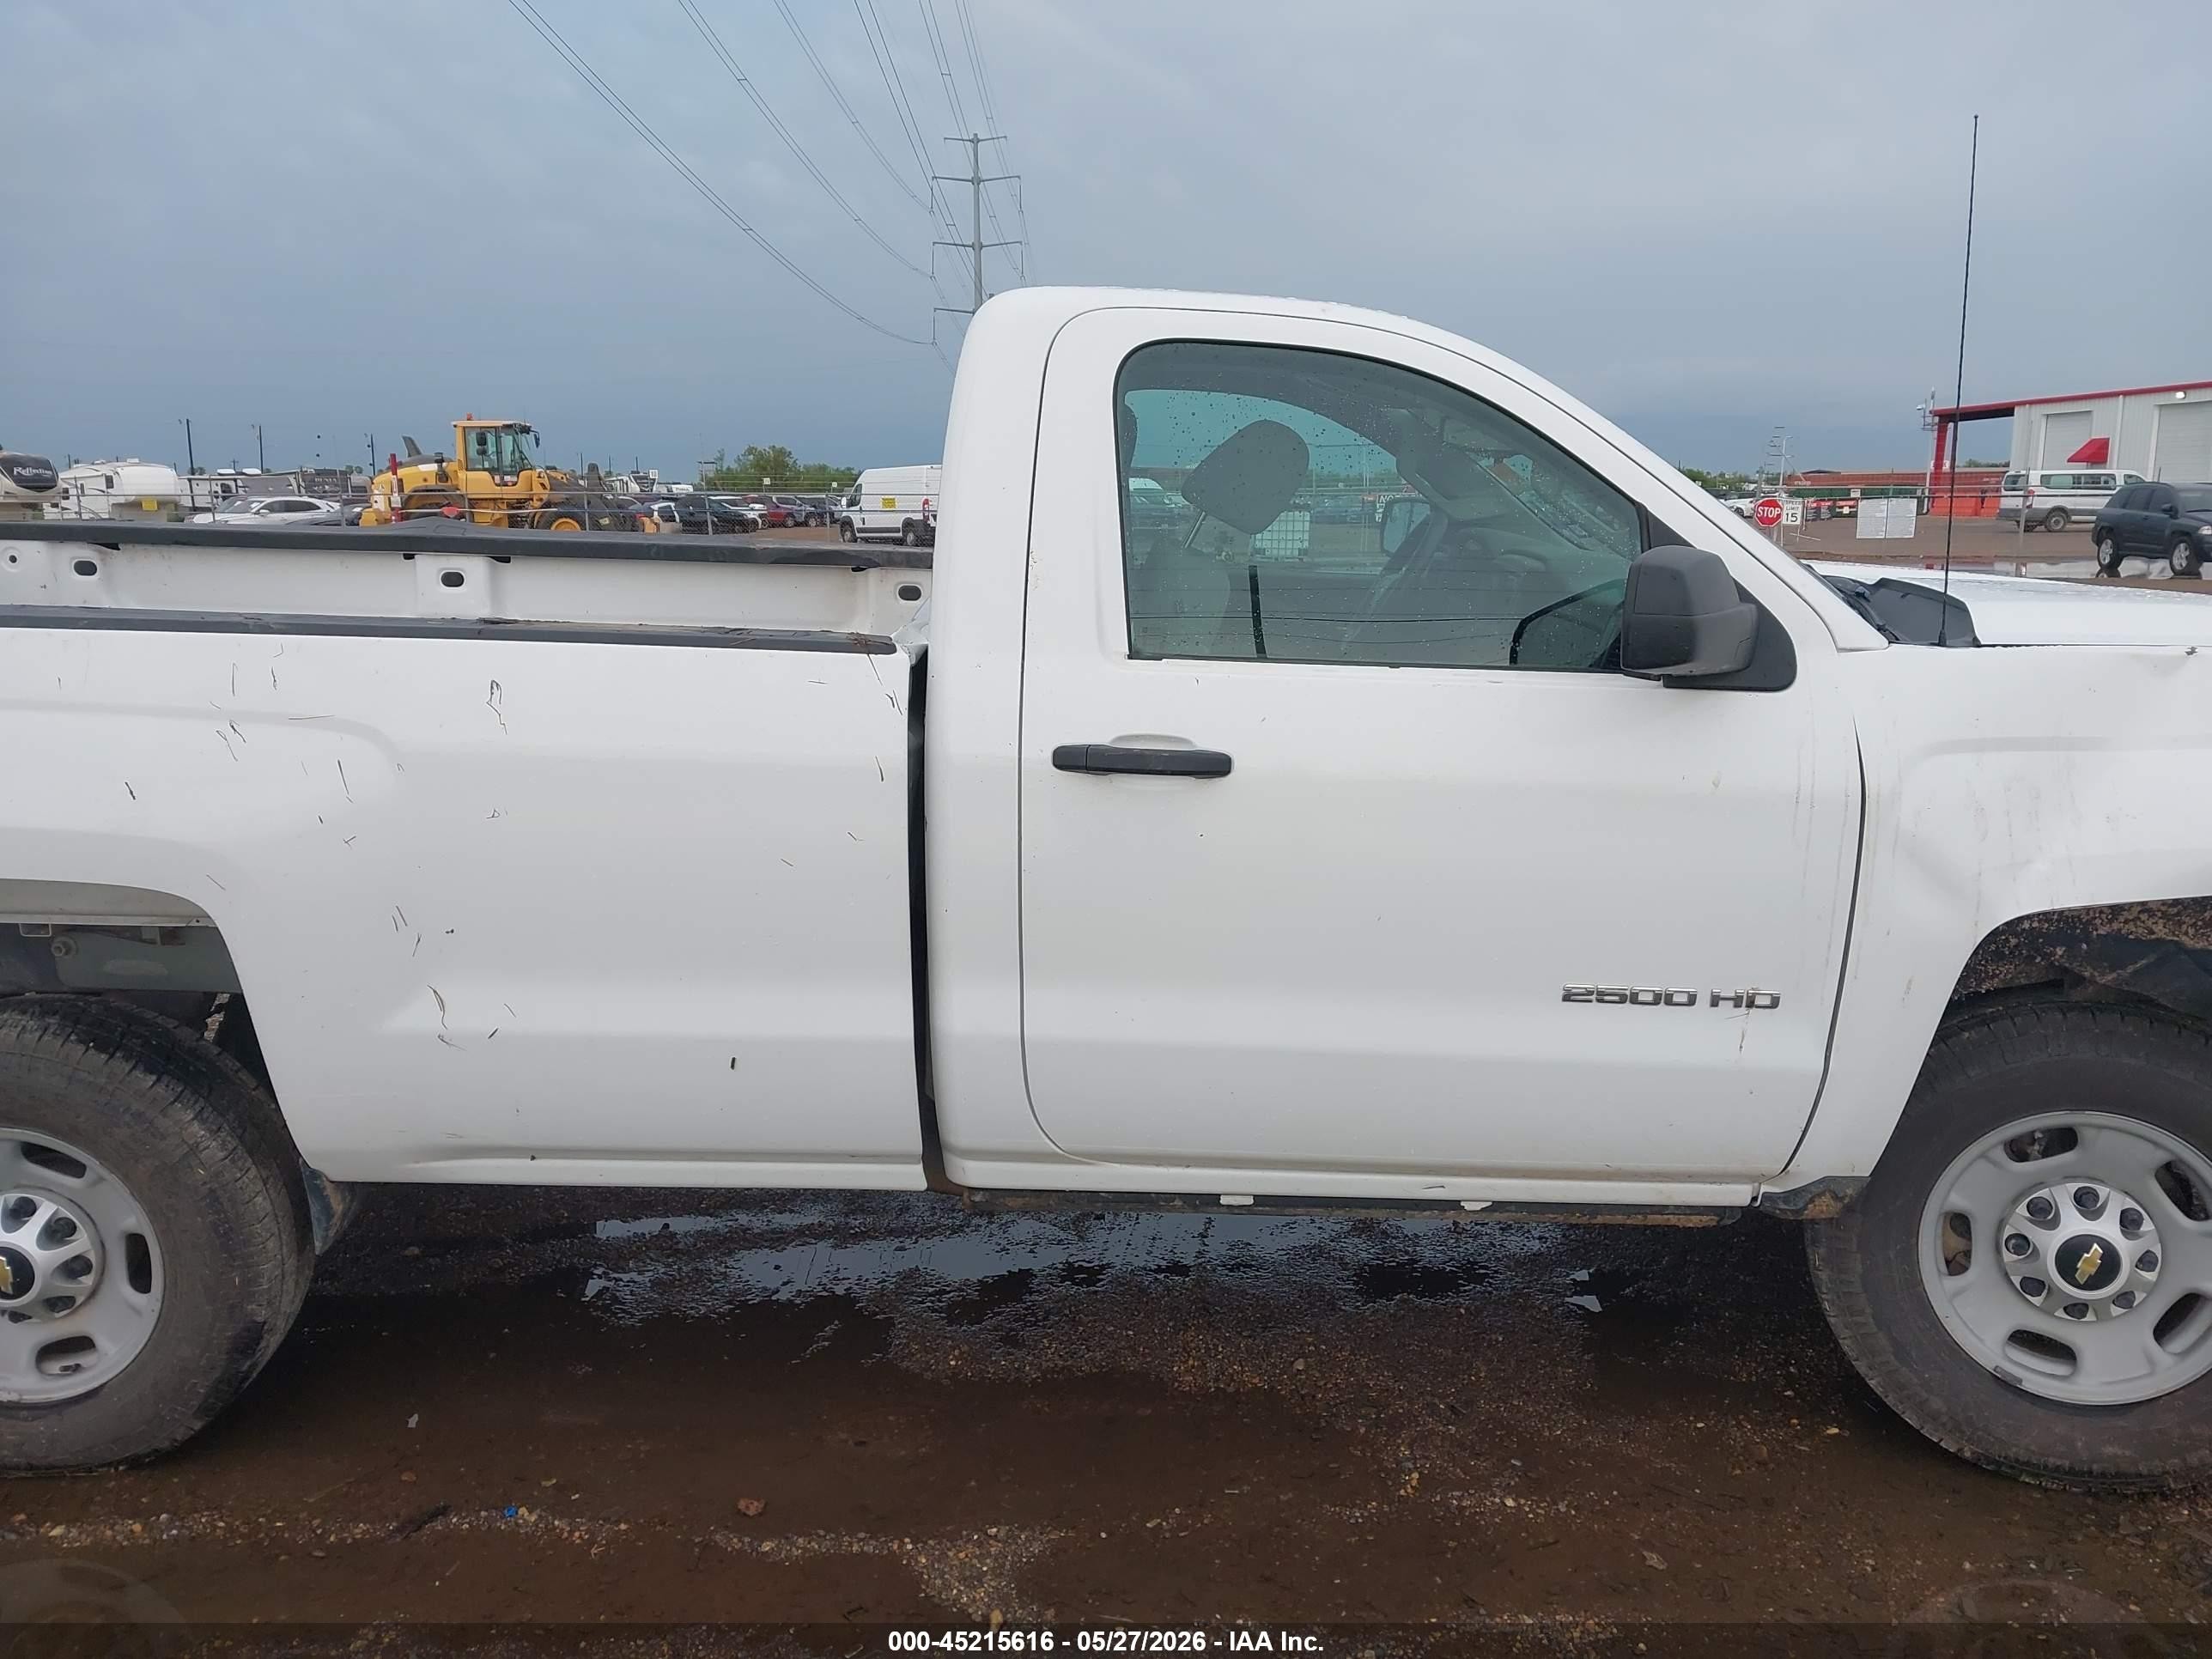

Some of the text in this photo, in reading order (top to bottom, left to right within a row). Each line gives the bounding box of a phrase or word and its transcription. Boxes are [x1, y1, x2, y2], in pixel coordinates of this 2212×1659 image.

[13, 466, 52, 477] Reflection
[1757, 506, 1782, 518] STOP
[1785, 512, 1798, 522] 15
[1561, 983, 1781, 1009] 2500 HD
